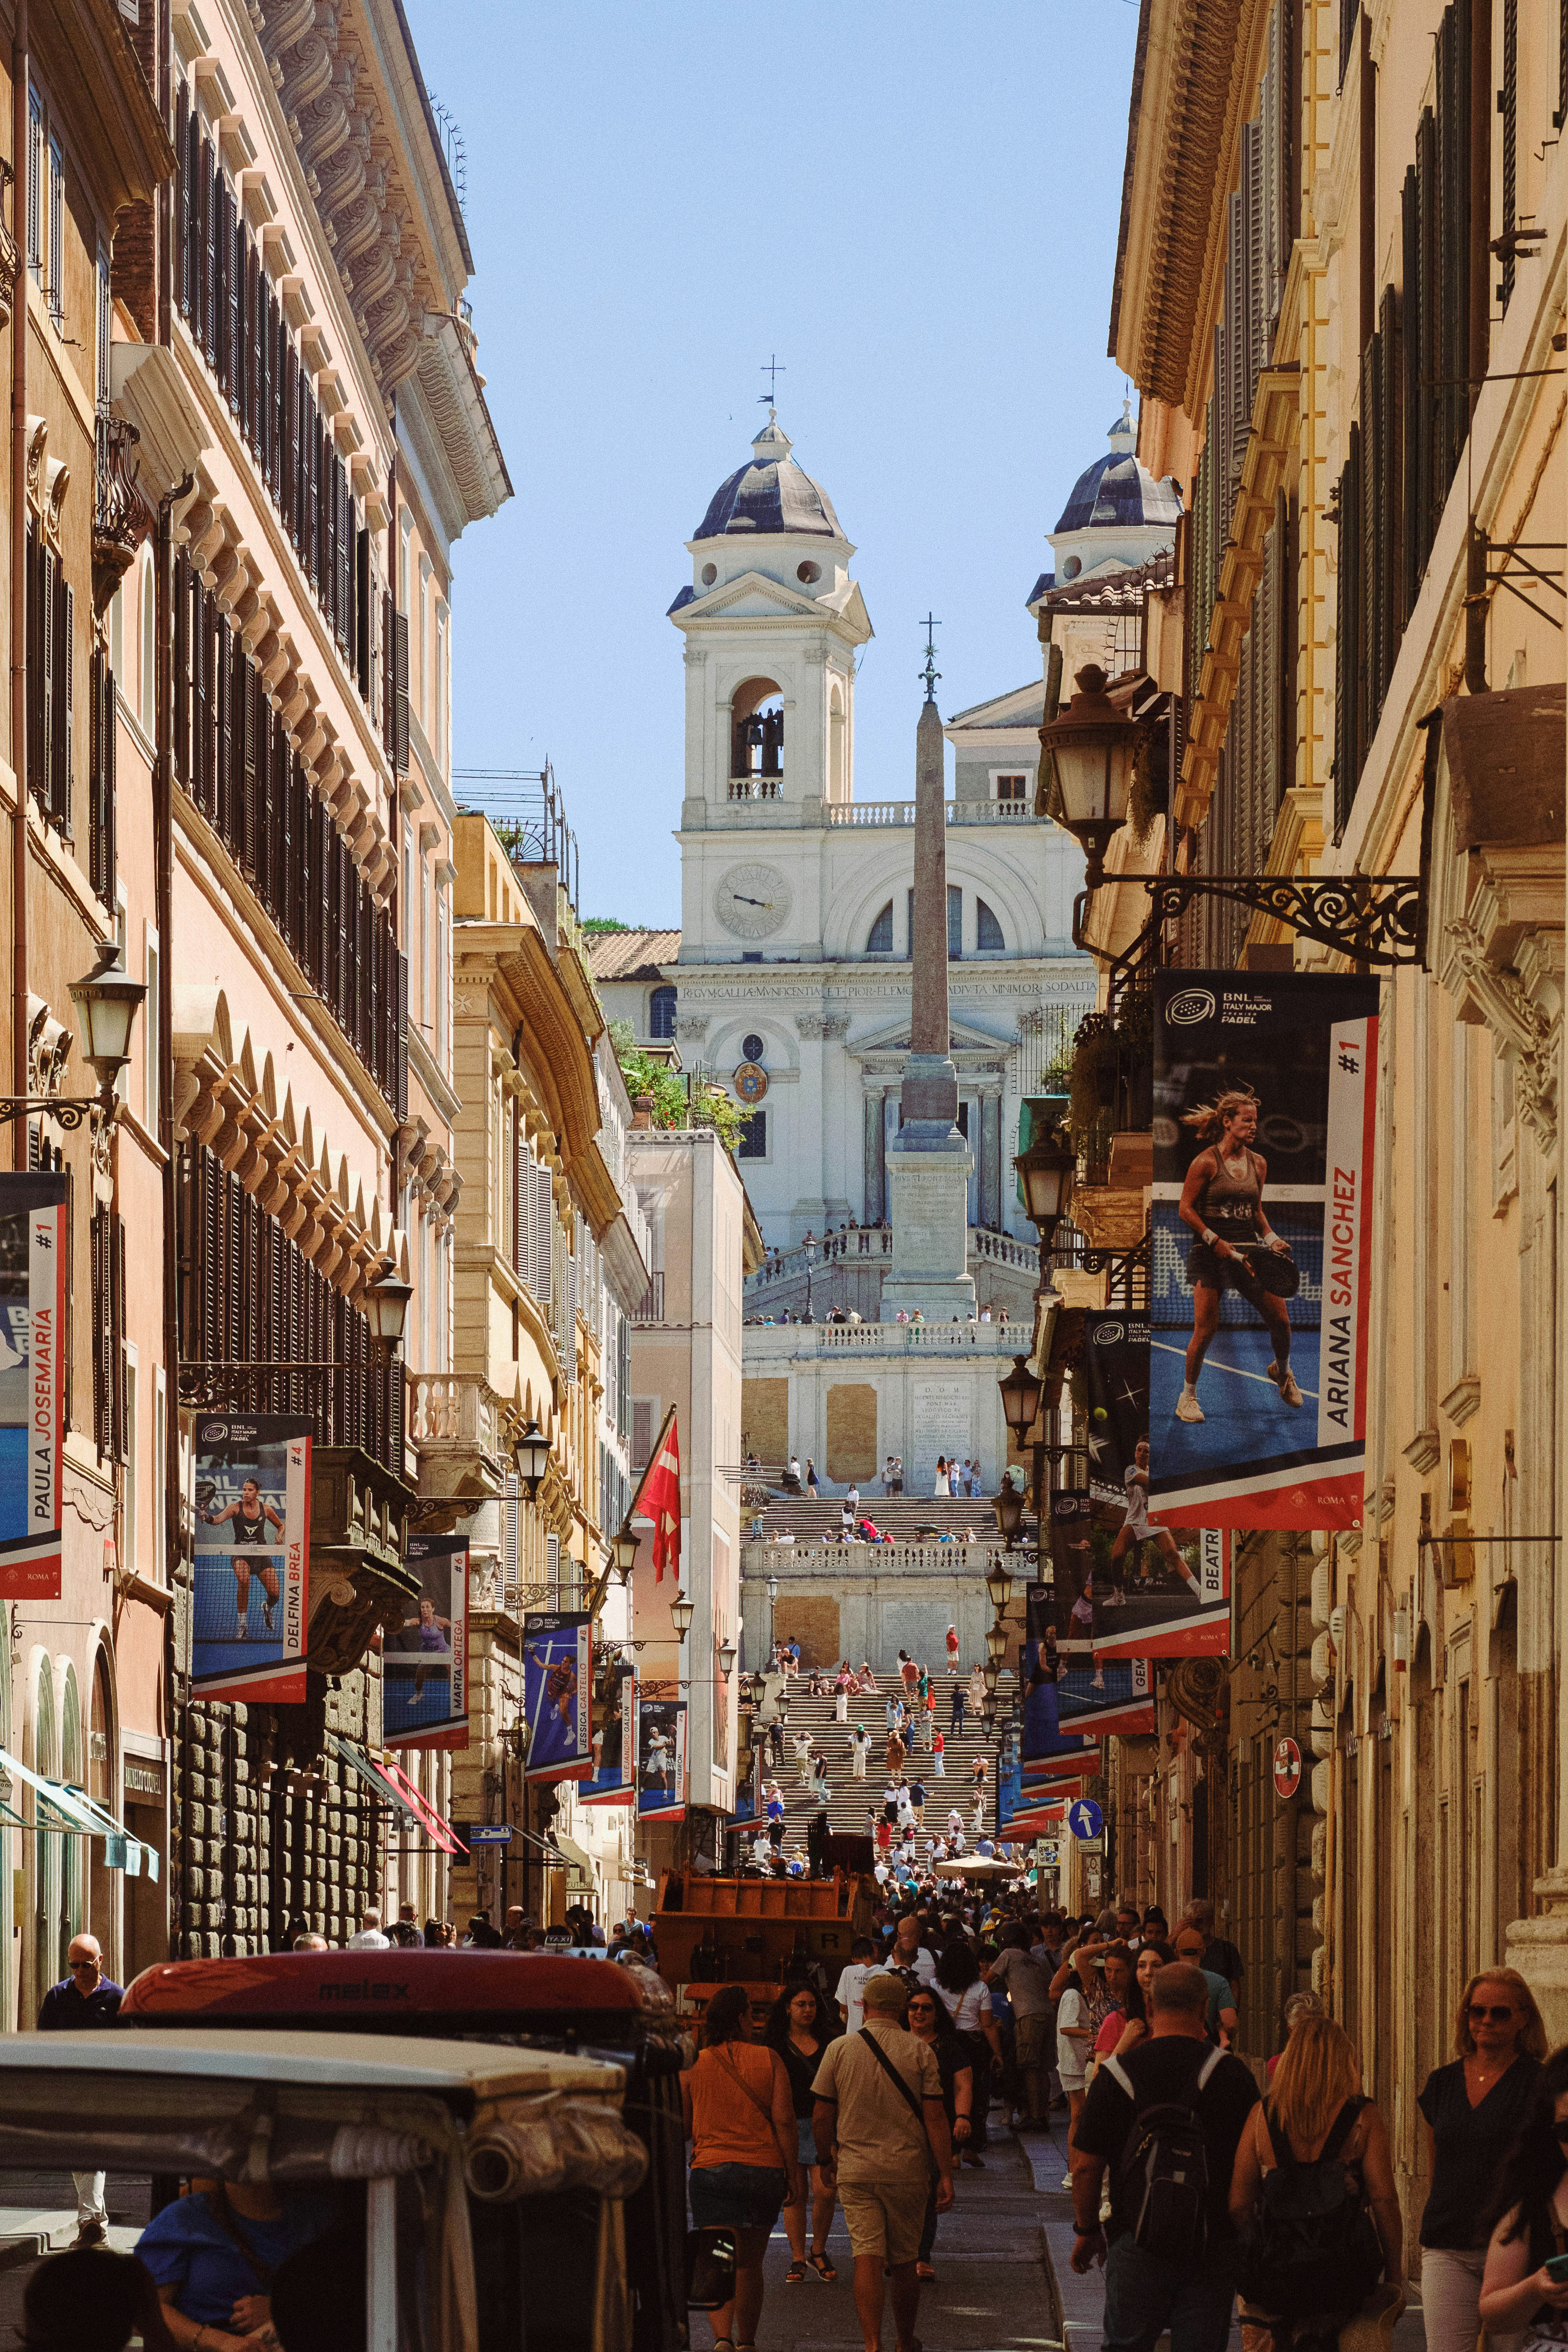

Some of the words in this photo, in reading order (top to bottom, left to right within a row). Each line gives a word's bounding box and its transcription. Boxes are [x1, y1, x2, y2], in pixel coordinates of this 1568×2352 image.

[1223, 993, 1251, 1001] BNL
[1338, 1040, 1360, 1074] #1
[35, 1224, 52, 1249] #1
[1330, 1166, 1355, 1306] SANCHEZ
[32, 1309, 52, 1442] JOSEMARÍA
[1327, 1315, 1351, 1428] ARIANA
[291, 1447, 302, 1466] #4
[34, 1447, 51, 1519] PAULA
[1318, 1496, 1345, 1505] ROMA
[289, 1542, 300, 1582] BREA
[454, 1558, 463, 1573] #6
[288, 1585, 300, 1649] DELFINA
[454, 1619, 462, 1666] ORTEGA
[454, 1669, 462, 1709] MARTA
[821, 1933, 839, 1948] R
[318, 1979, 409, 2000] melex
